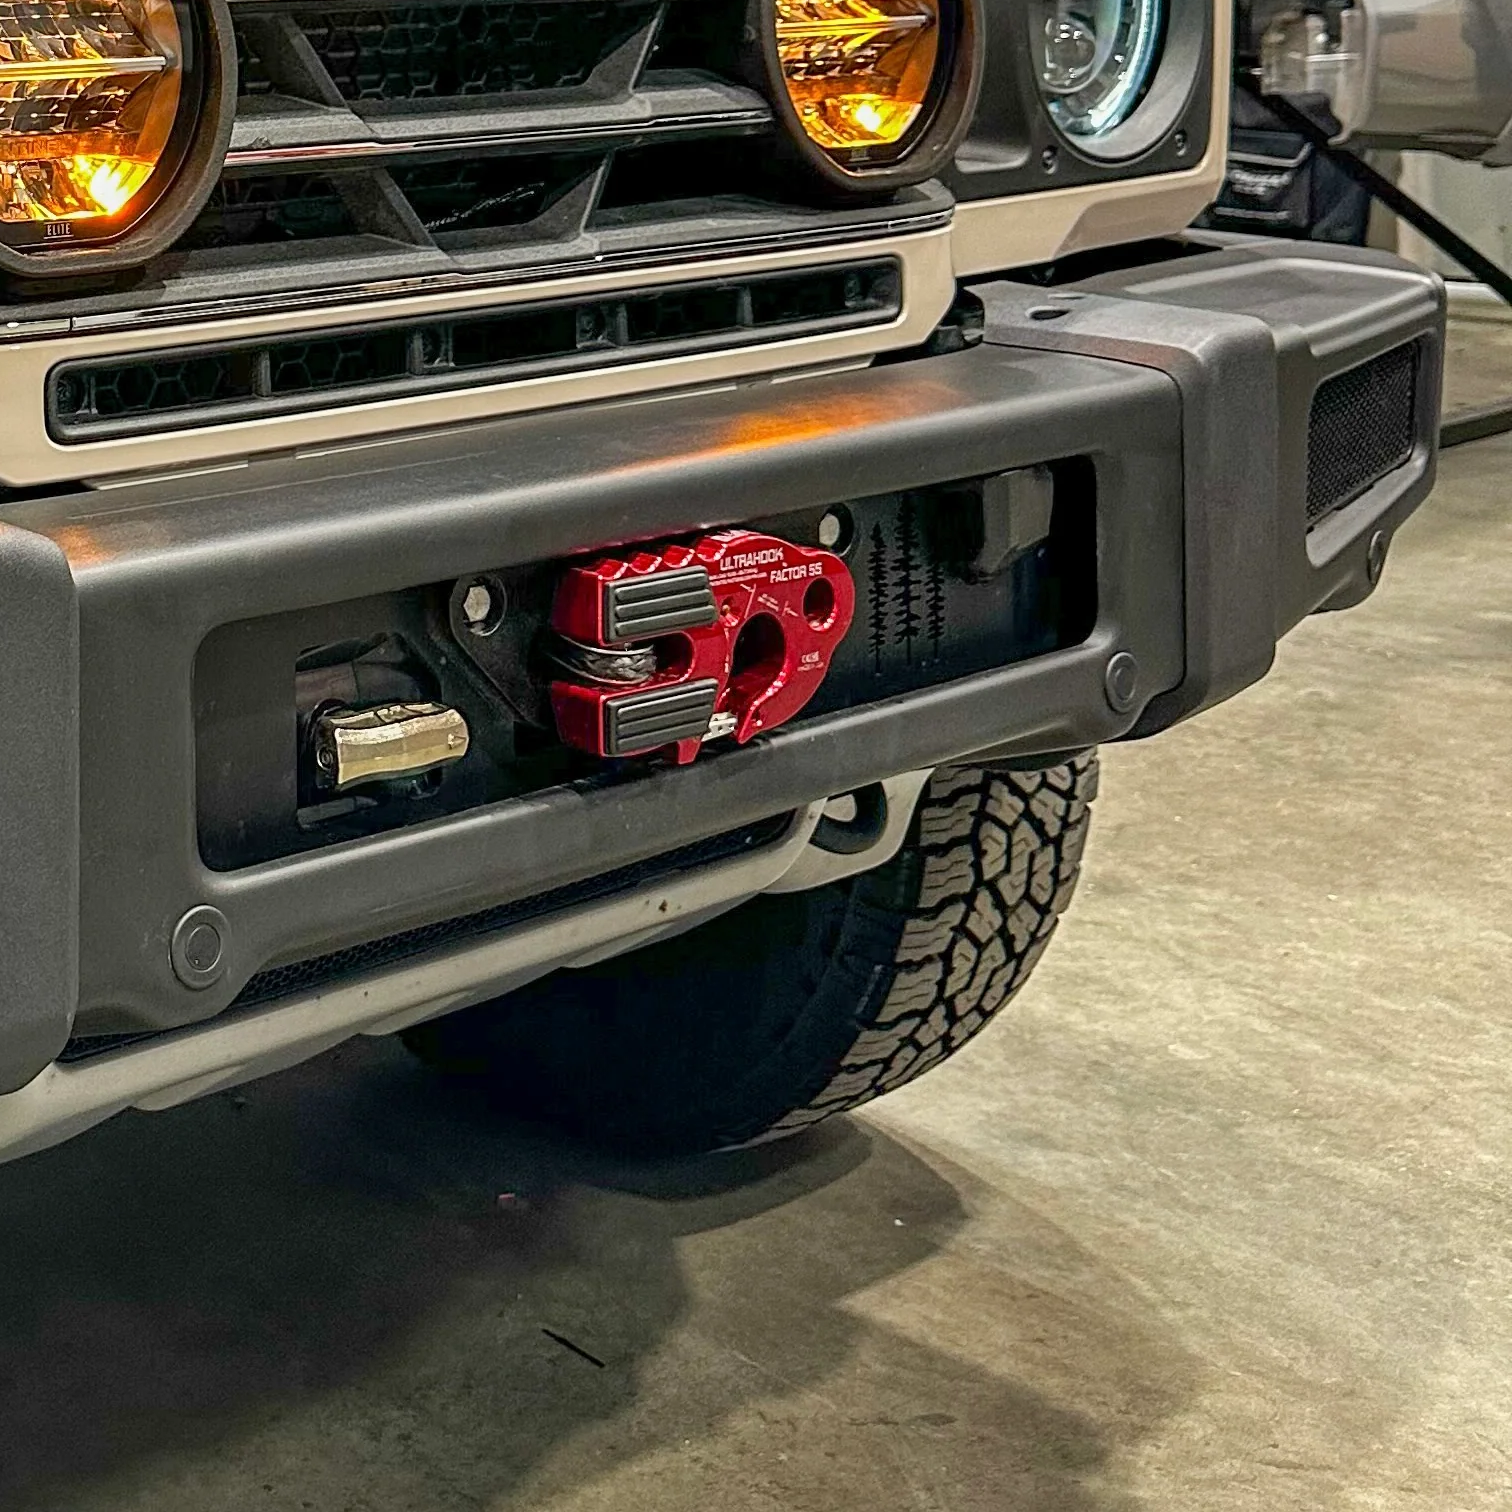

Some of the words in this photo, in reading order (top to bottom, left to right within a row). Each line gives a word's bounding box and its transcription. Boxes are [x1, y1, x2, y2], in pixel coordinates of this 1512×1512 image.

[47, 222, 71, 236] ELITE
[719, 547, 784, 571] ULTRAHOOK
[770, 565, 807, 583] FACTOR
